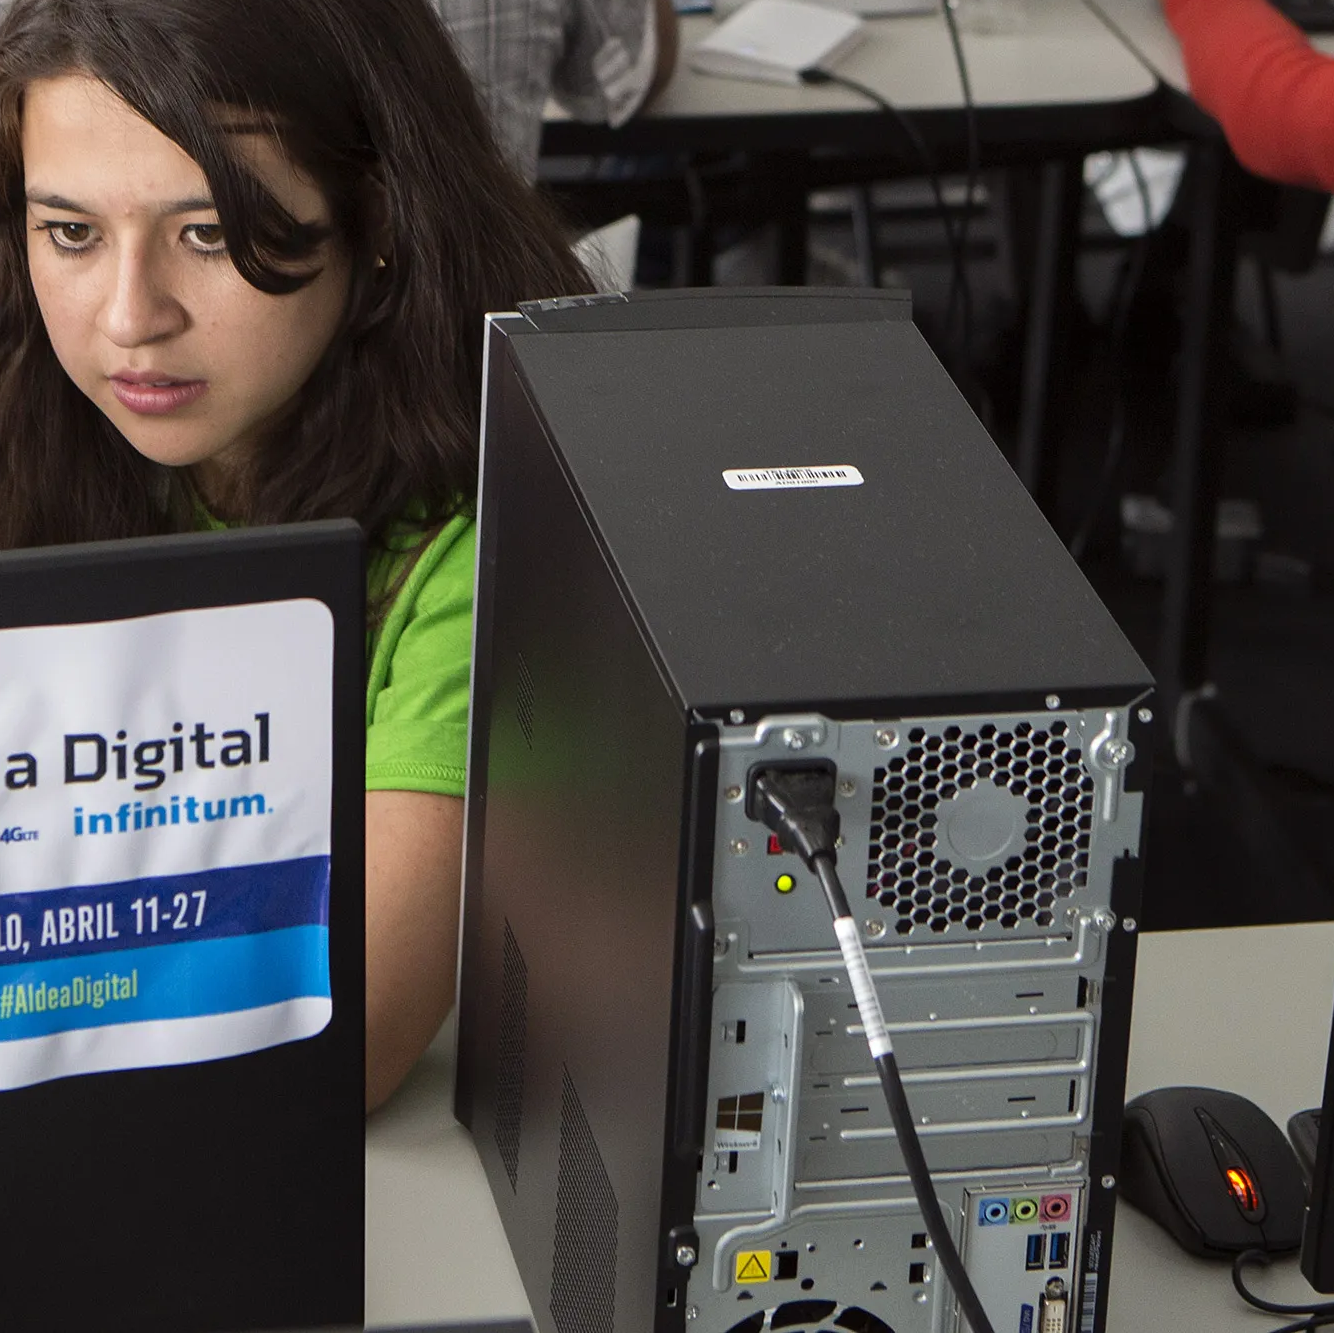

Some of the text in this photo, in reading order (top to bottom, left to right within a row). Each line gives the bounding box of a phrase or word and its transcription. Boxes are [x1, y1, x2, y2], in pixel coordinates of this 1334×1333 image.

[64, 712, 269, 792] Digital
[41, 902, 119, 947] ABRIL
[131, 890, 207, 934] 11-27
[0, 969, 138, 1019] #AldeaDigital
